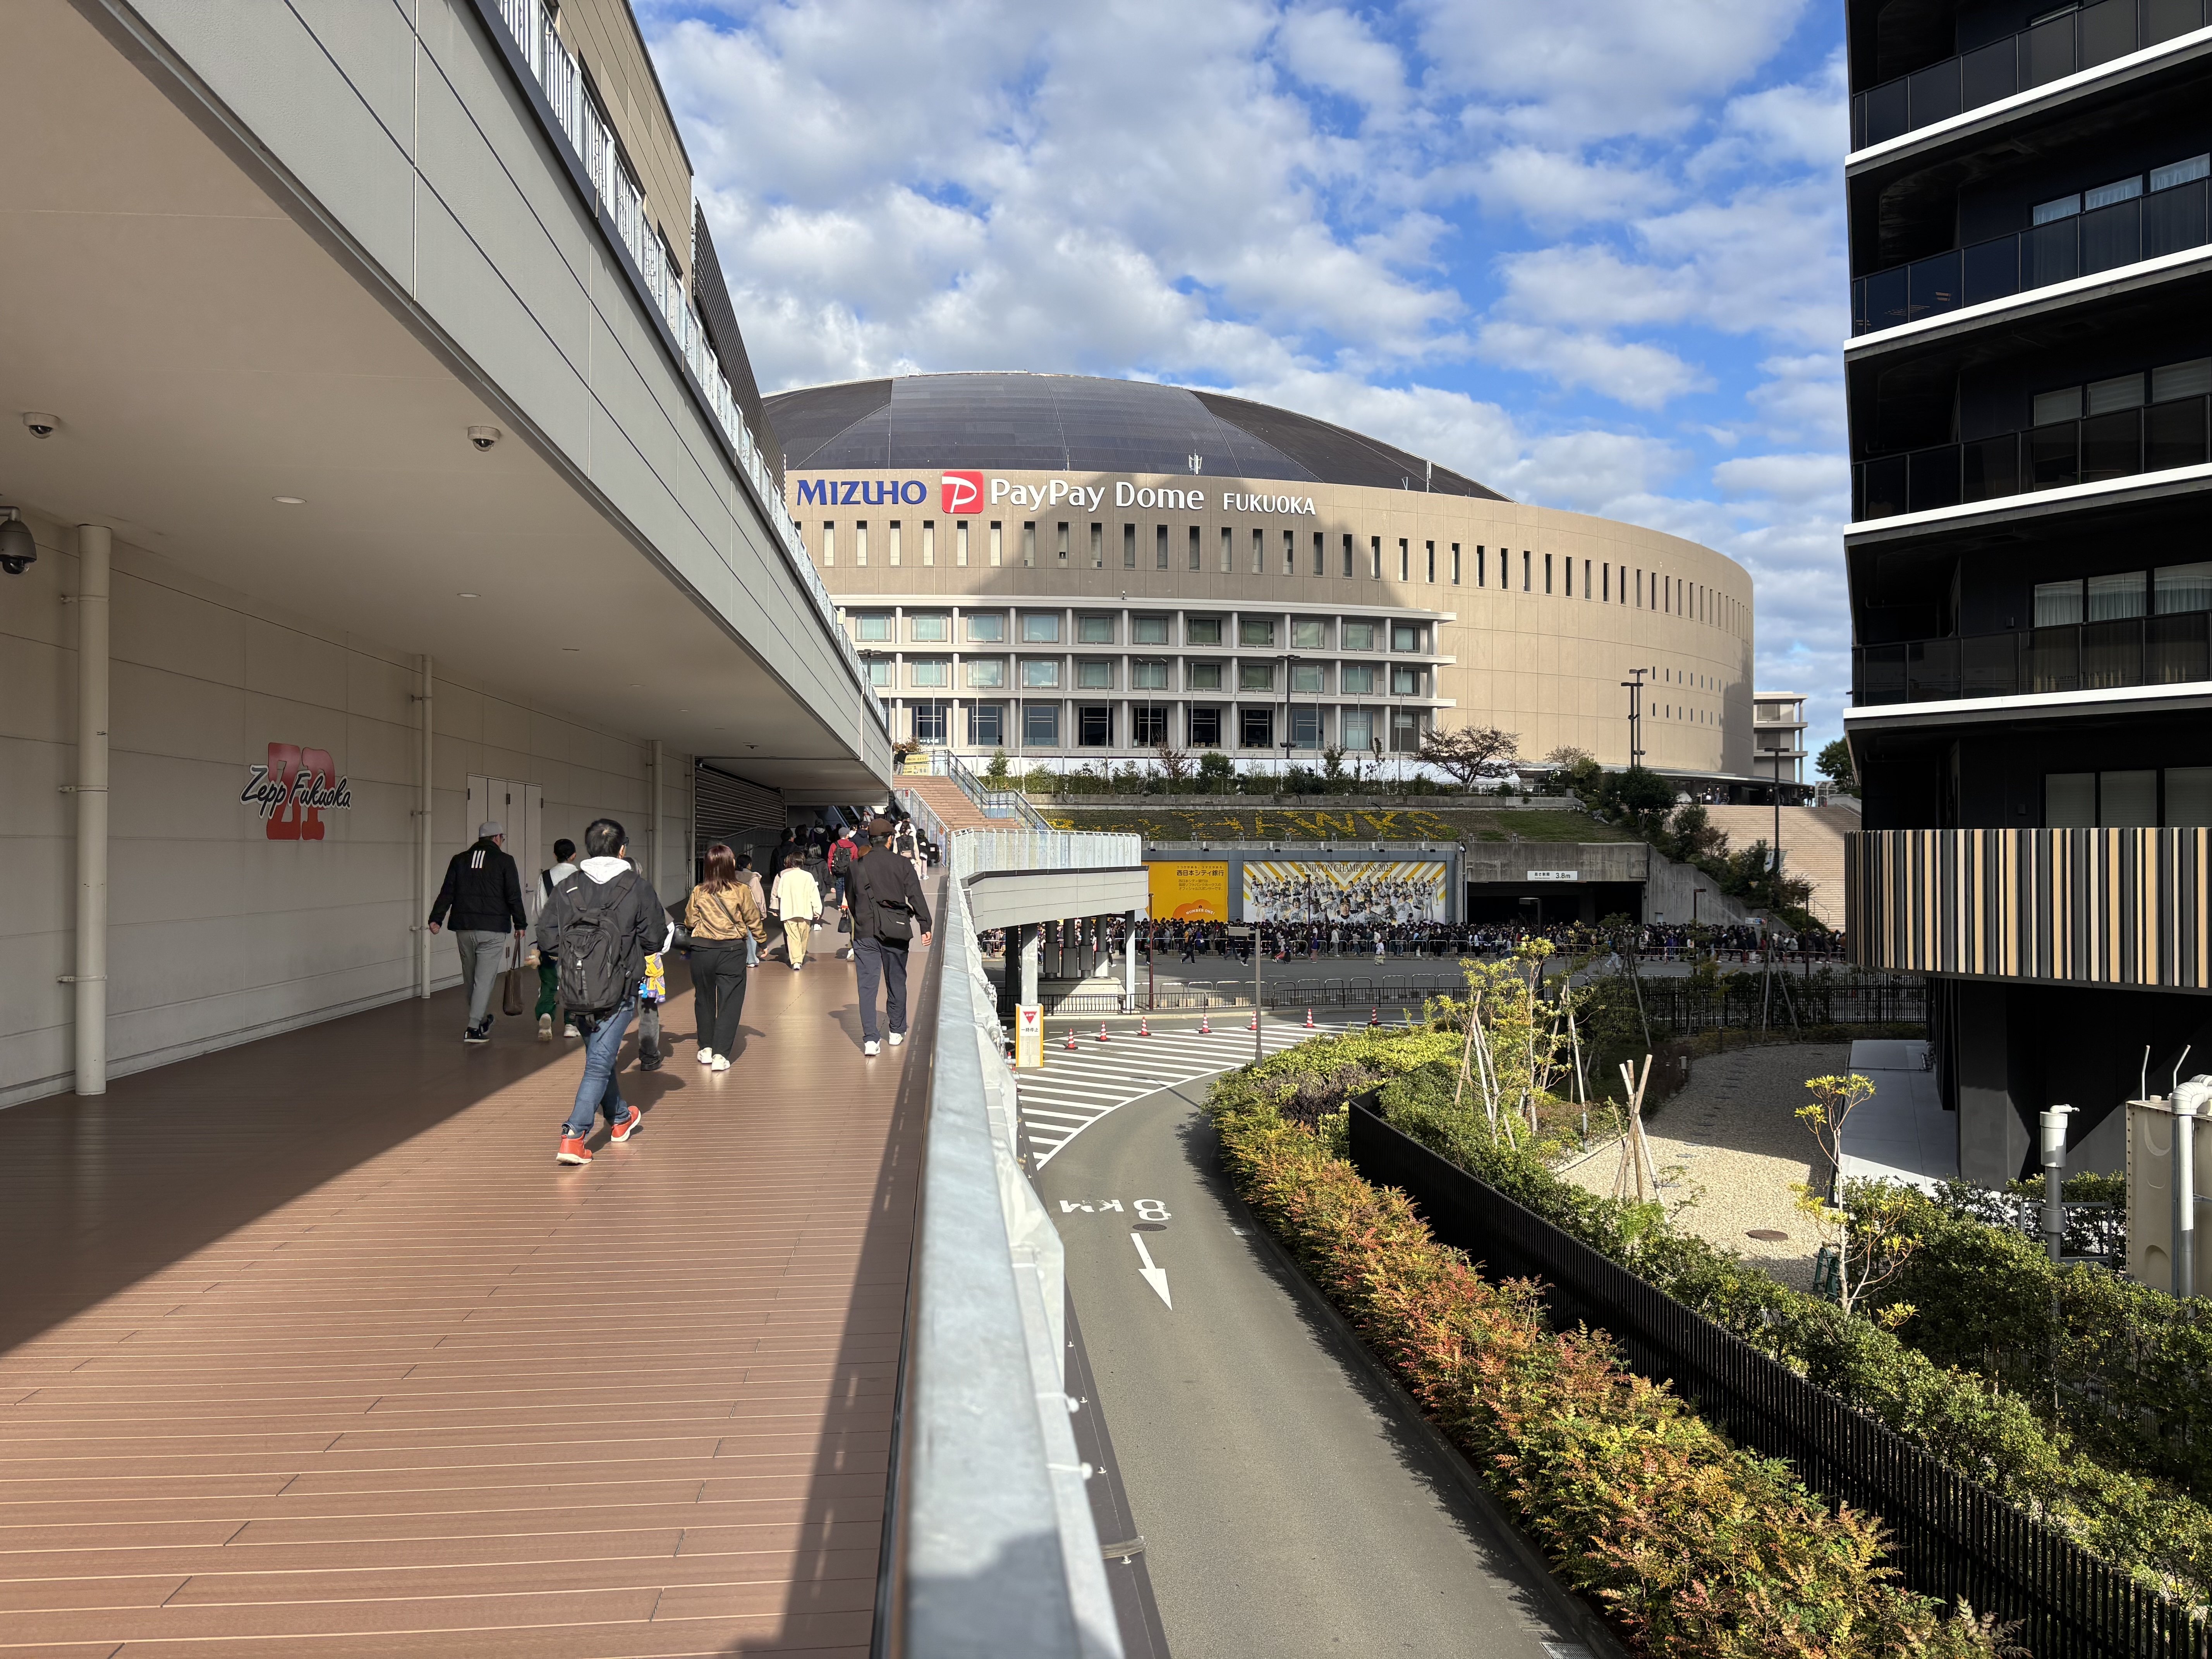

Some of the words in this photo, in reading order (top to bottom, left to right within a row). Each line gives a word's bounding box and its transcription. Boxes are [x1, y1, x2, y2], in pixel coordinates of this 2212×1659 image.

[797, 479, 927, 505] MIZUHO
[991, 479, 1105, 512] PayPay
[1116, 481, 1204, 510] Dome
[1223, 493, 1316, 515] FUKUOKA
[239, 765, 287, 819] Zepp
[288, 770, 351, 810] Fukuoka
[1133, 1199, 1172, 1221] 8
